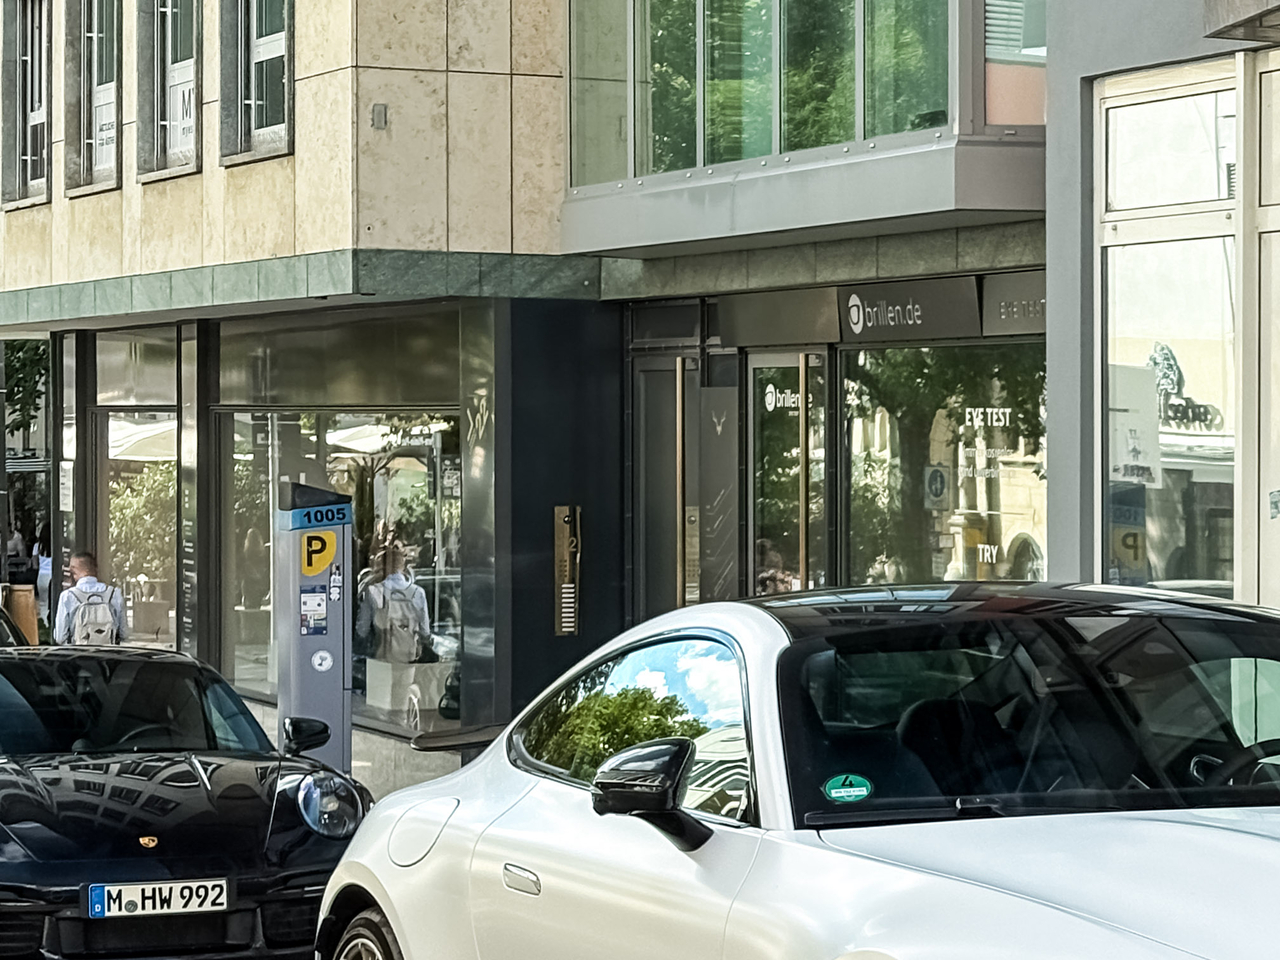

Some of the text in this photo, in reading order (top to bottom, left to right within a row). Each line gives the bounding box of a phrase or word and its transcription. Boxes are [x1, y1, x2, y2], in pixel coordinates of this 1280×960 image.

[182, 87, 195, 120] M
[864, 298, 922, 327] brillen.de
[999, 301, 1018, 319] EYE
[965, 407, 1012, 427] EYE TEST
[303, 507, 347, 524] 1005
[306, 535, 327, 567] P
[569, 537, 577, 551] 2
[977, 544, 999, 564] TRY
[841, 775, 855, 788] 4
[95, 904, 101, 912] D
[107, 884, 225, 912] M HW 992
